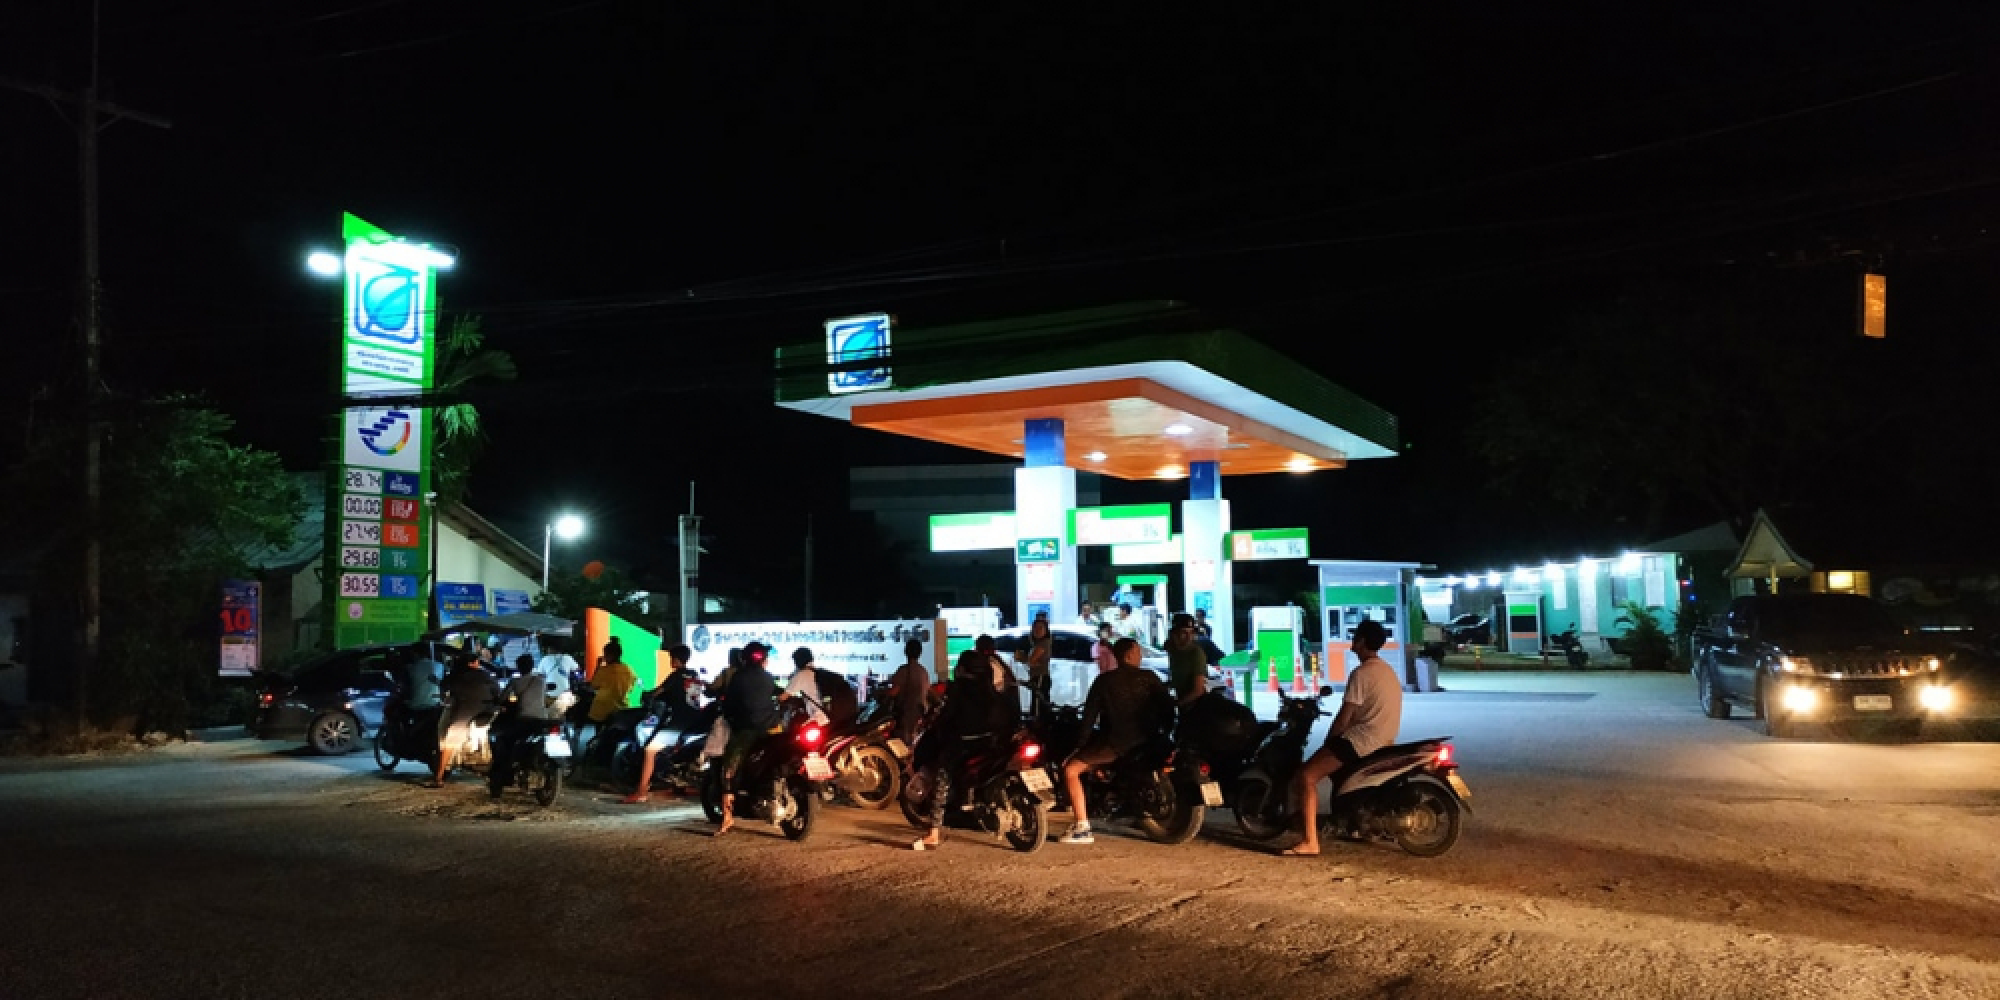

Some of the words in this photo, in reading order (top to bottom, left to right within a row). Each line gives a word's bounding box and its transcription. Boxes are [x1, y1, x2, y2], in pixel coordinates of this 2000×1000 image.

[346, 497, 380, 514] 00.00
[344, 549, 379, 566] 29.68
[344, 575, 379, 592] 30.55
